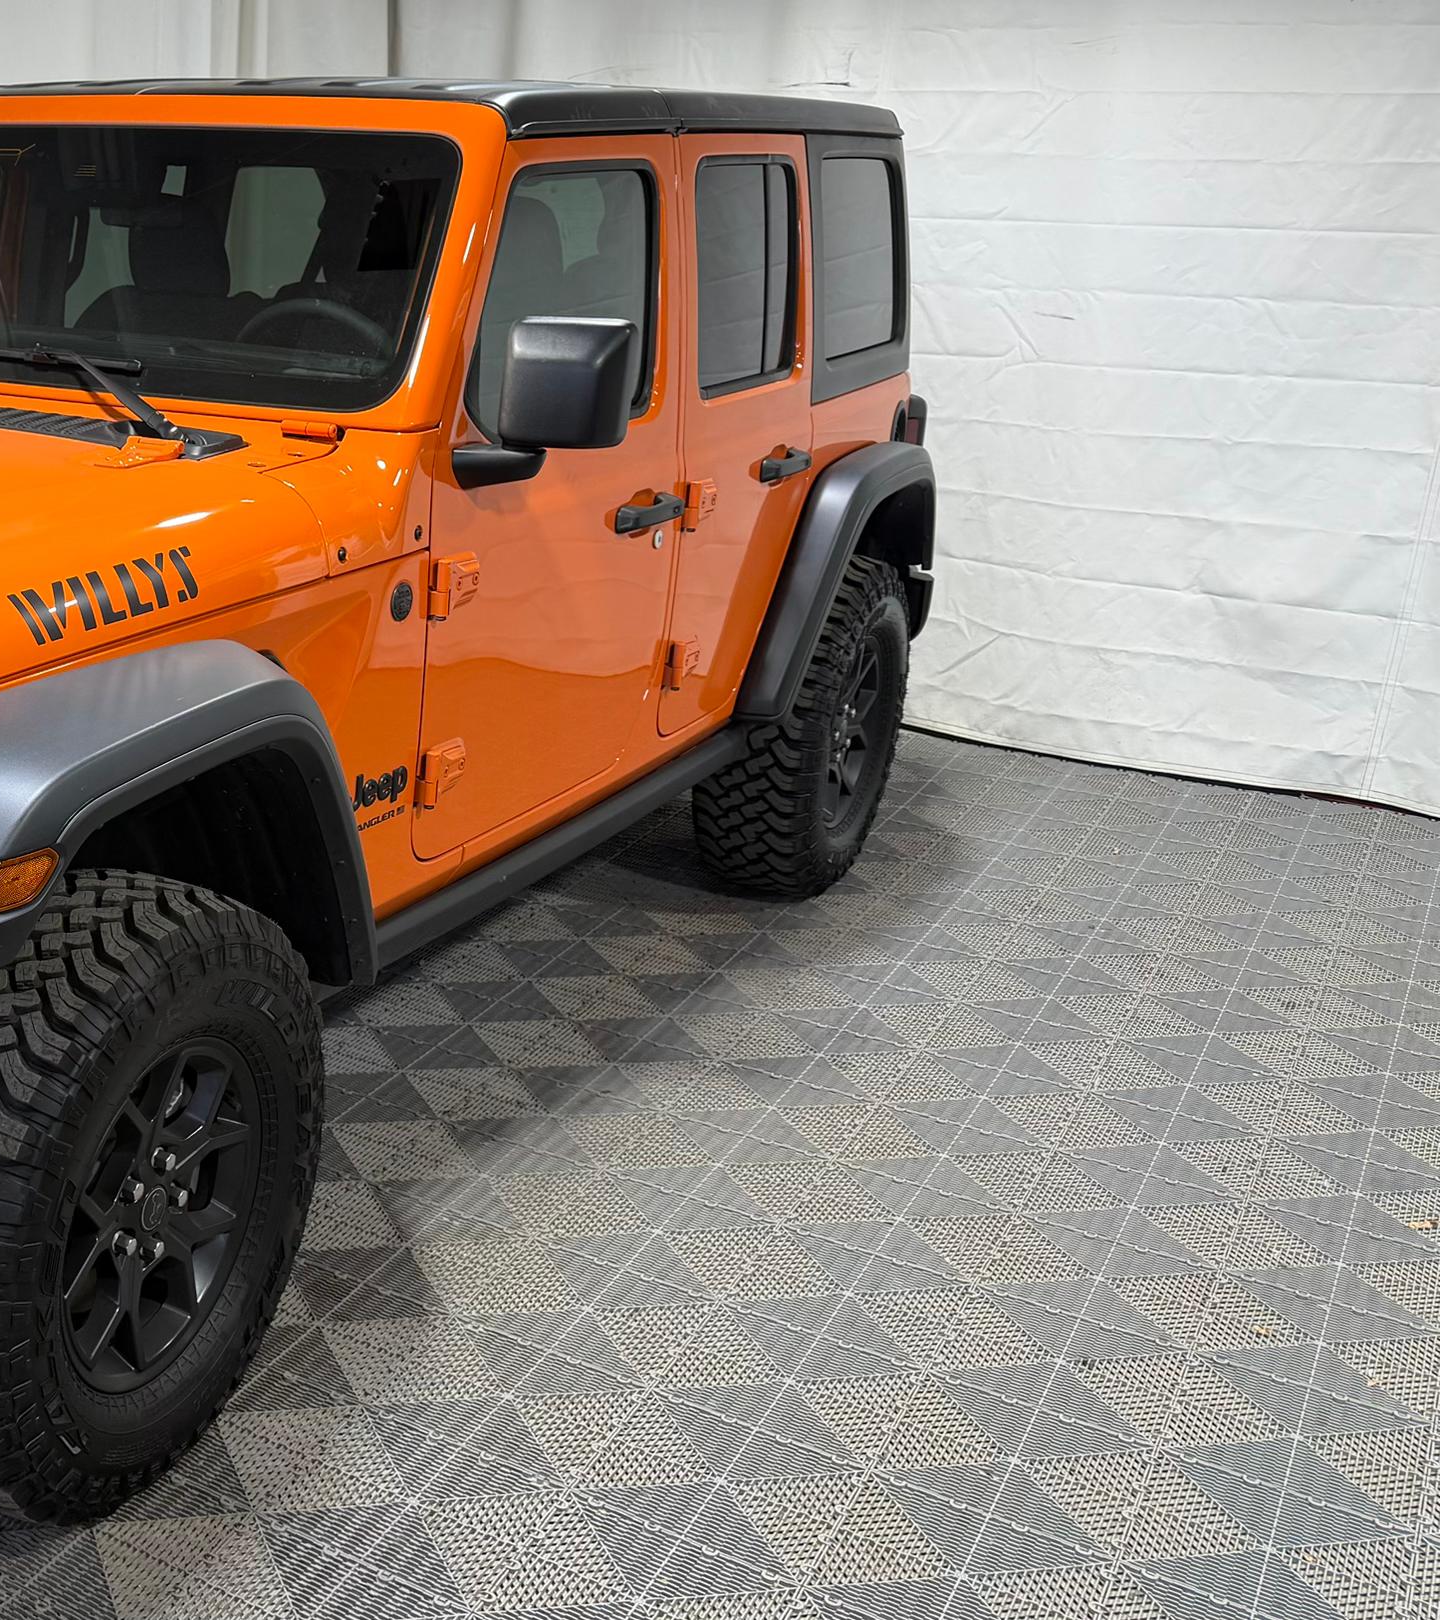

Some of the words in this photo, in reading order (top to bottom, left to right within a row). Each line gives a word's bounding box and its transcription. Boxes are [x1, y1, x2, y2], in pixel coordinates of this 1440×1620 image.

[6, 546, 199, 645] WILLYS
[351, 765, 408, 812] Jeep
[357, 809, 395, 831] ANGLER
